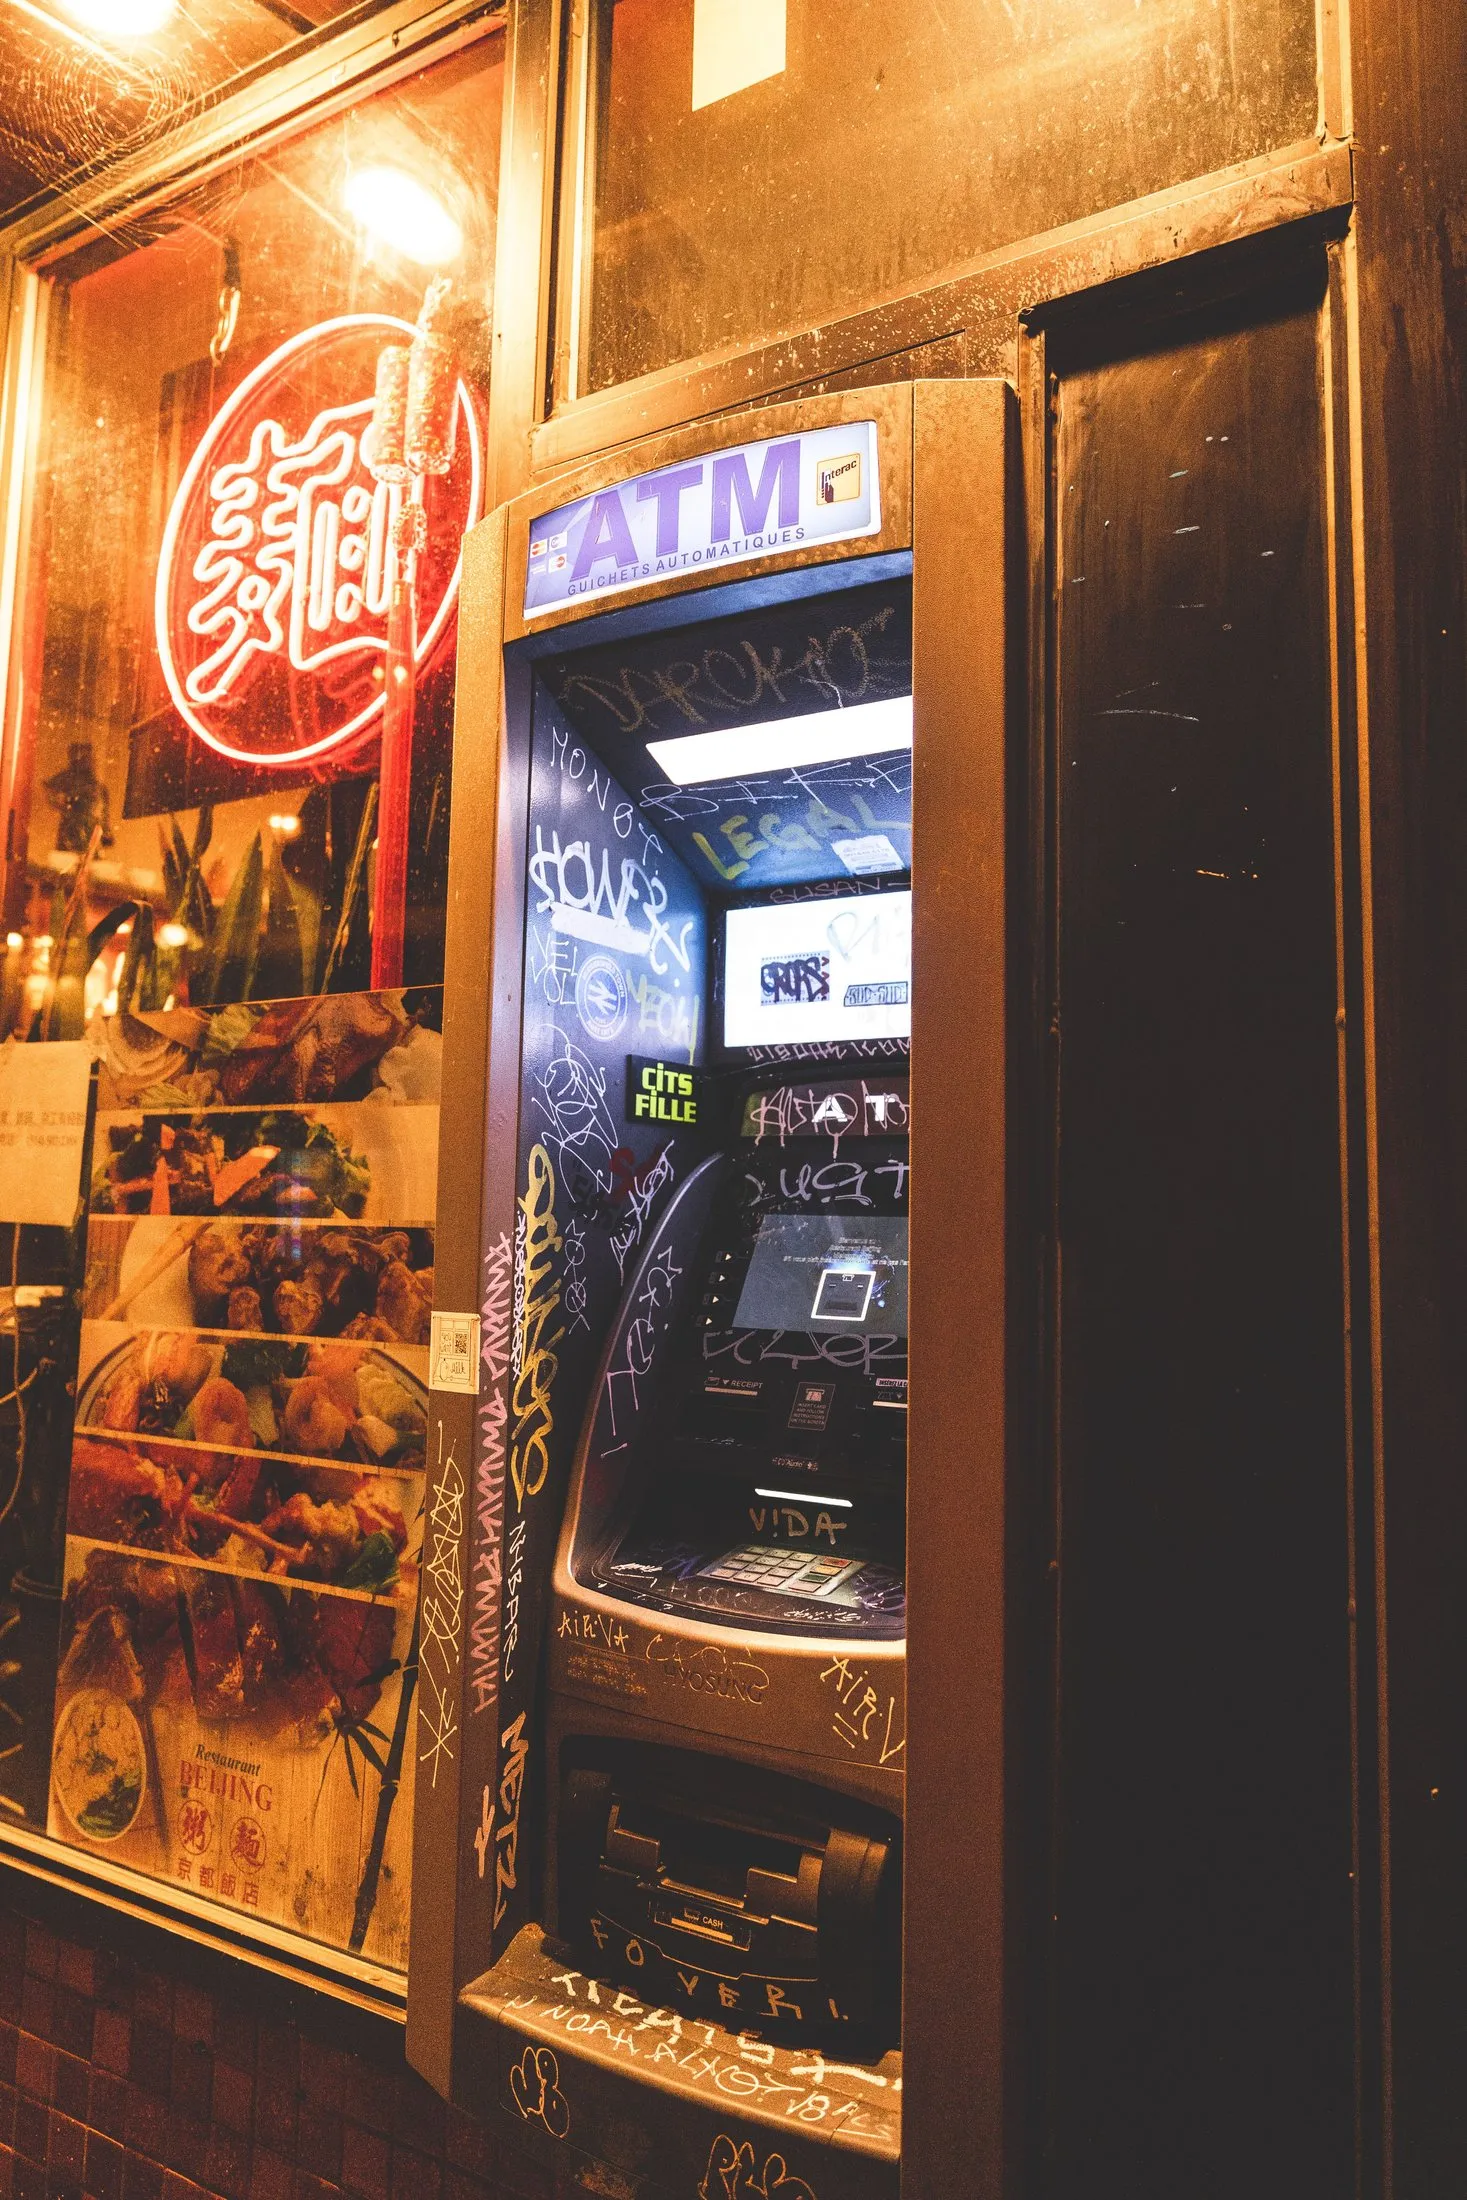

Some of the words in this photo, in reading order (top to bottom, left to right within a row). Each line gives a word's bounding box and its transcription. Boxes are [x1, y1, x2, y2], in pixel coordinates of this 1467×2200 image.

[820, 459, 858, 491] Interac
[569, 440, 801, 582] ATM
[567, 563, 650, 597] GUICHETS
[656, 527, 806, 572] AUTOMATIQUES
[812, 1095, 897, 1123] AT
[730, 1380, 763, 1389] RECEIPT
[195, 1743, 261, 1777] Restaurant
[179, 1759, 273, 1811] BEIJING
[177, 1857, 260, 1907] 京都飯店
[702, 1916, 724, 1930] CASH
